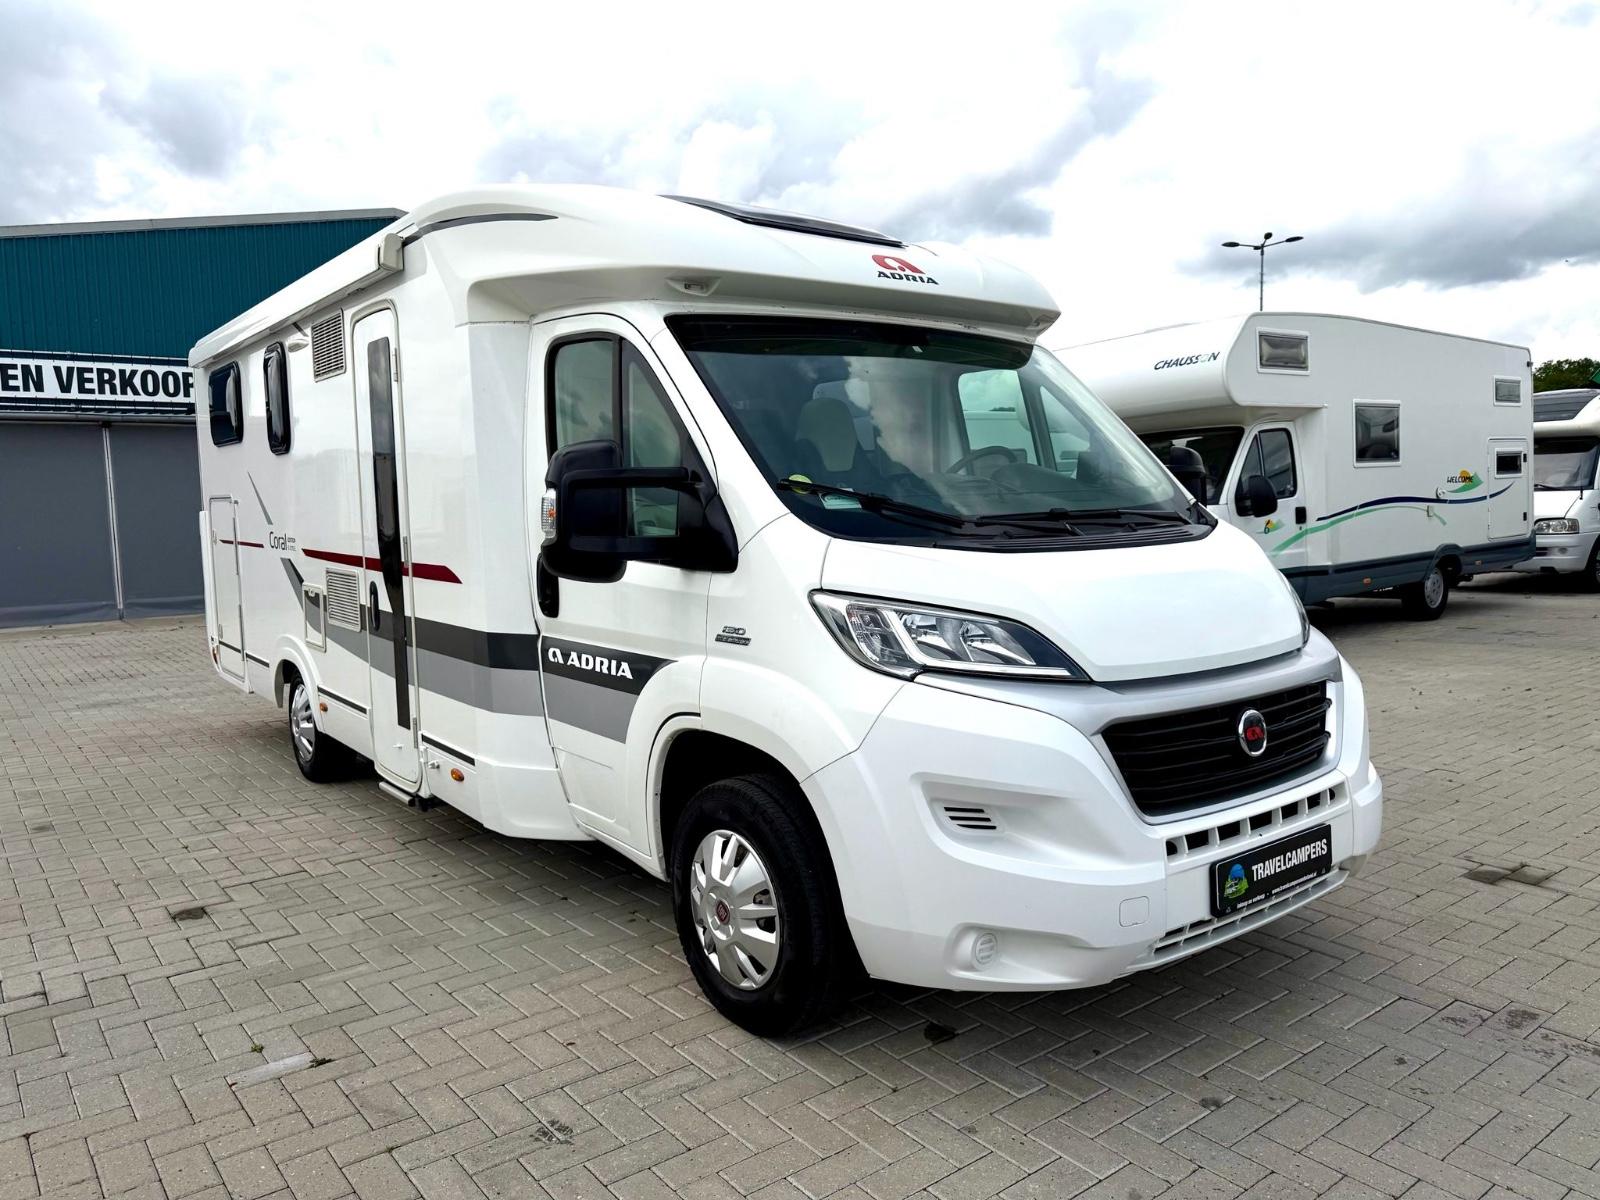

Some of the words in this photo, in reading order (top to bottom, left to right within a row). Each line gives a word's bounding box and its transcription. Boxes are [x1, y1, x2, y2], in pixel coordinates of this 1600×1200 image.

[877, 270, 939, 286] ADRIA
[1154, 351, 1221, 371] CHAUSSON
[0, 363, 45, 393] EN
[53, 365, 194, 398] VERKOOP
[1446, 475, 1474, 484] WELCOME
[269, 531, 288, 551] Coral
[566, 651, 633, 680] ADRIA
[1251, 838, 1328, 882] TRAVELCAMPERS
